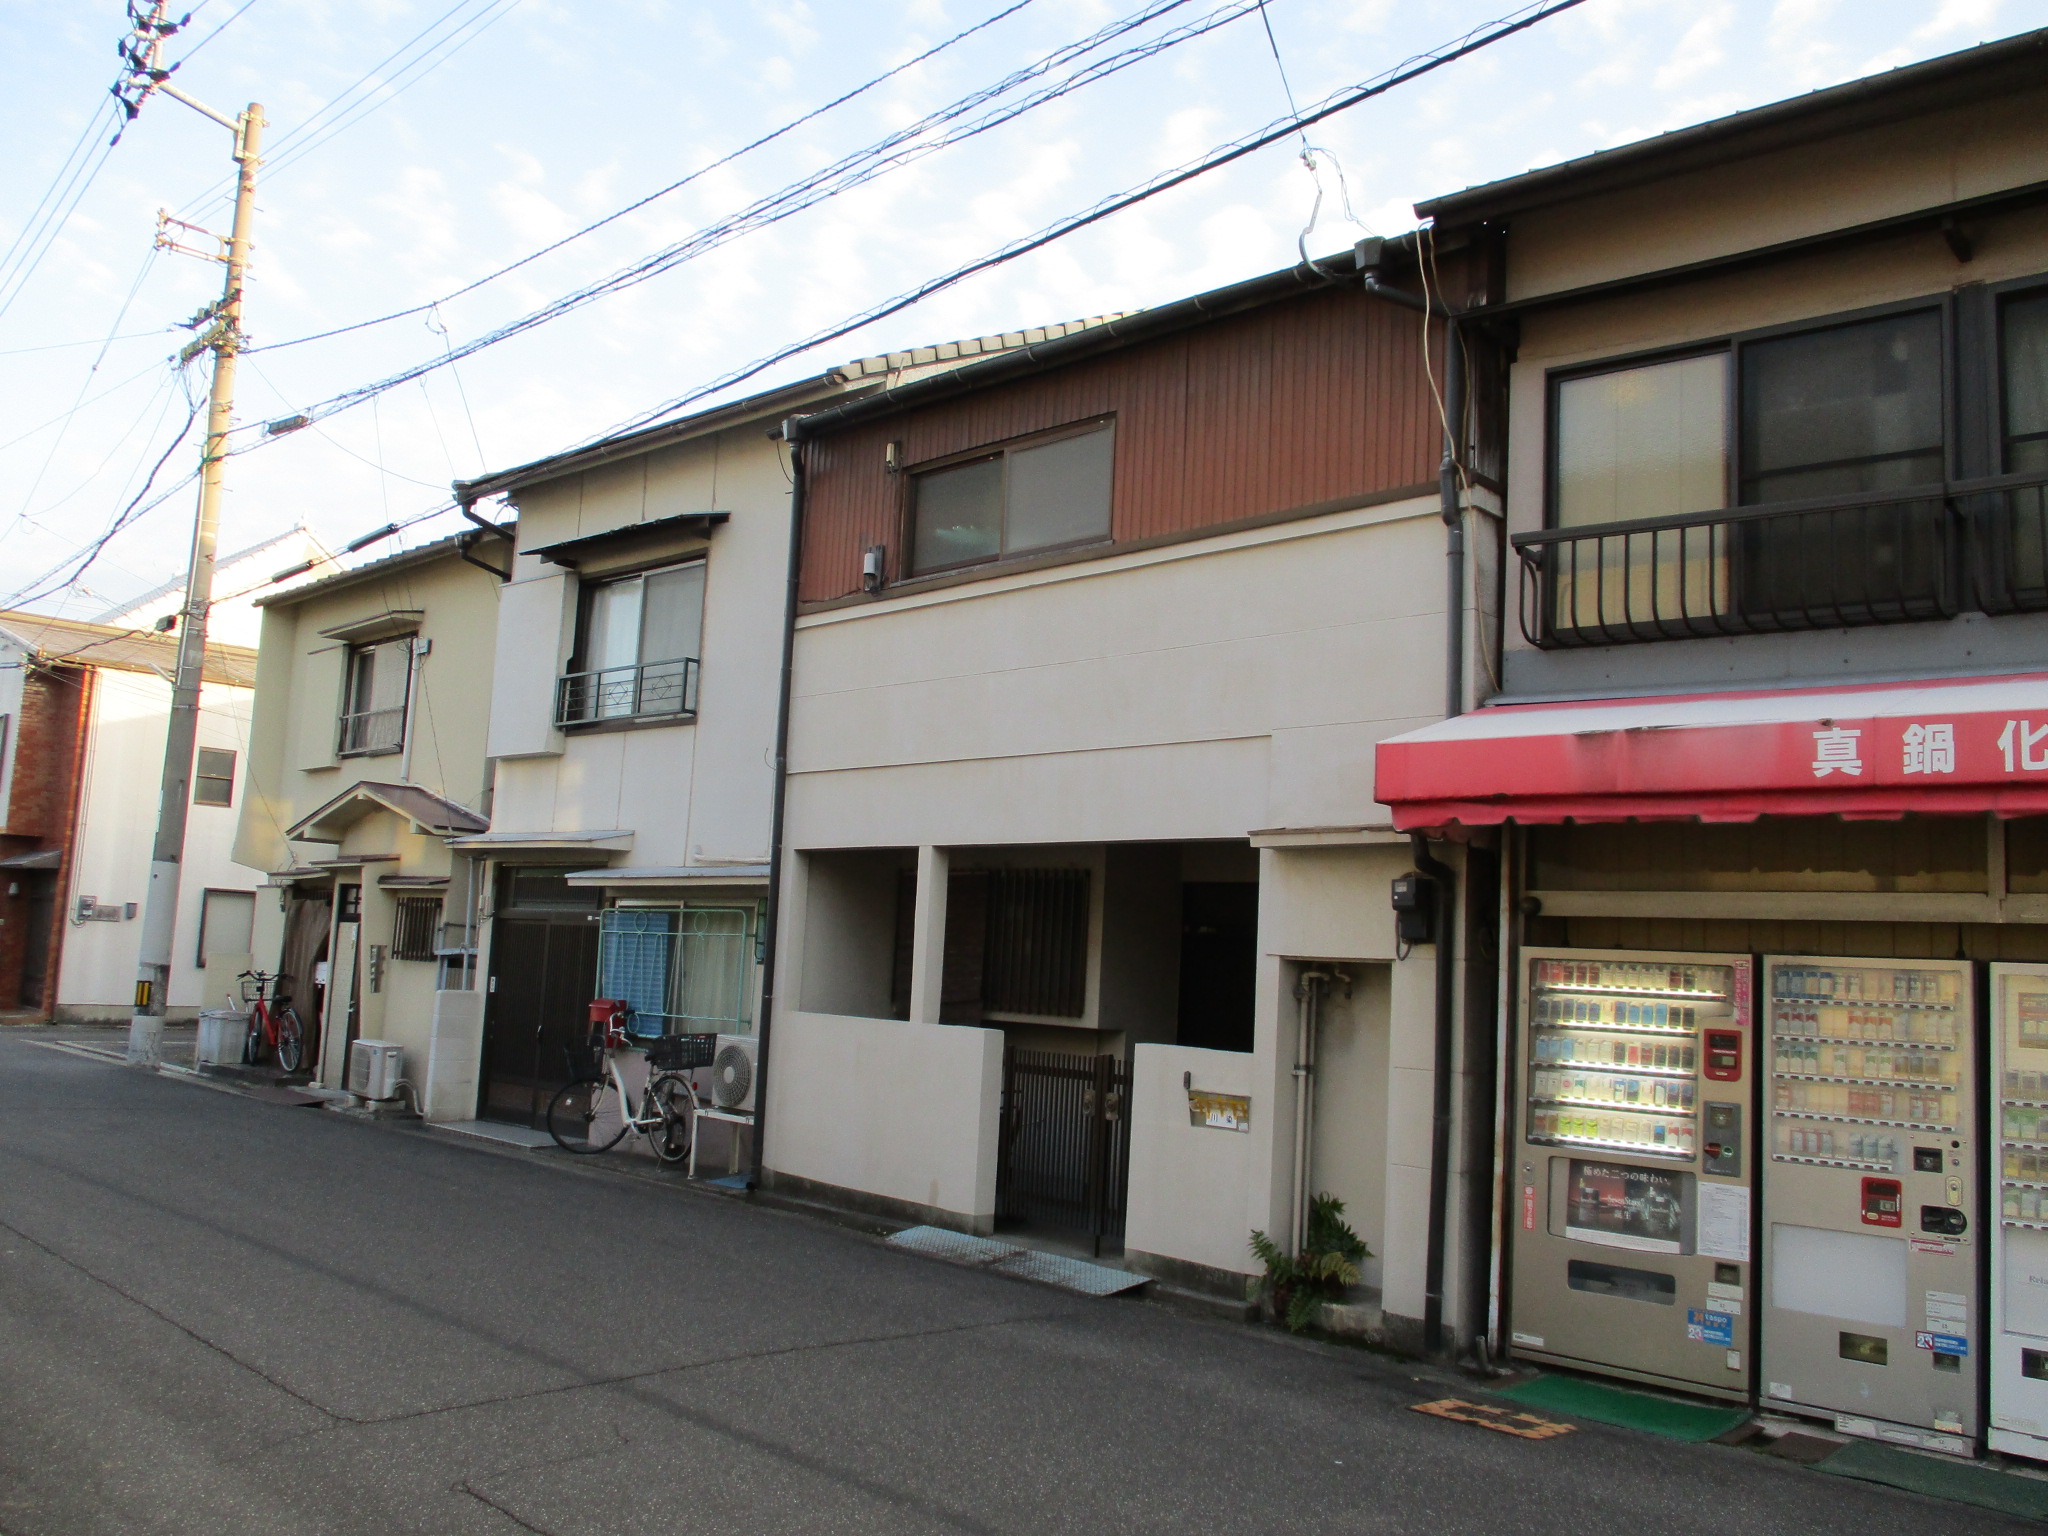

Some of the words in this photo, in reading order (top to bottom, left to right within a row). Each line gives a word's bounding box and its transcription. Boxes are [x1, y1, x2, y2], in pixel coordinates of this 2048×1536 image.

[1812, 719, 2048, 778] 真鍋化
[1705, 1313, 1727, 1323] taspo
